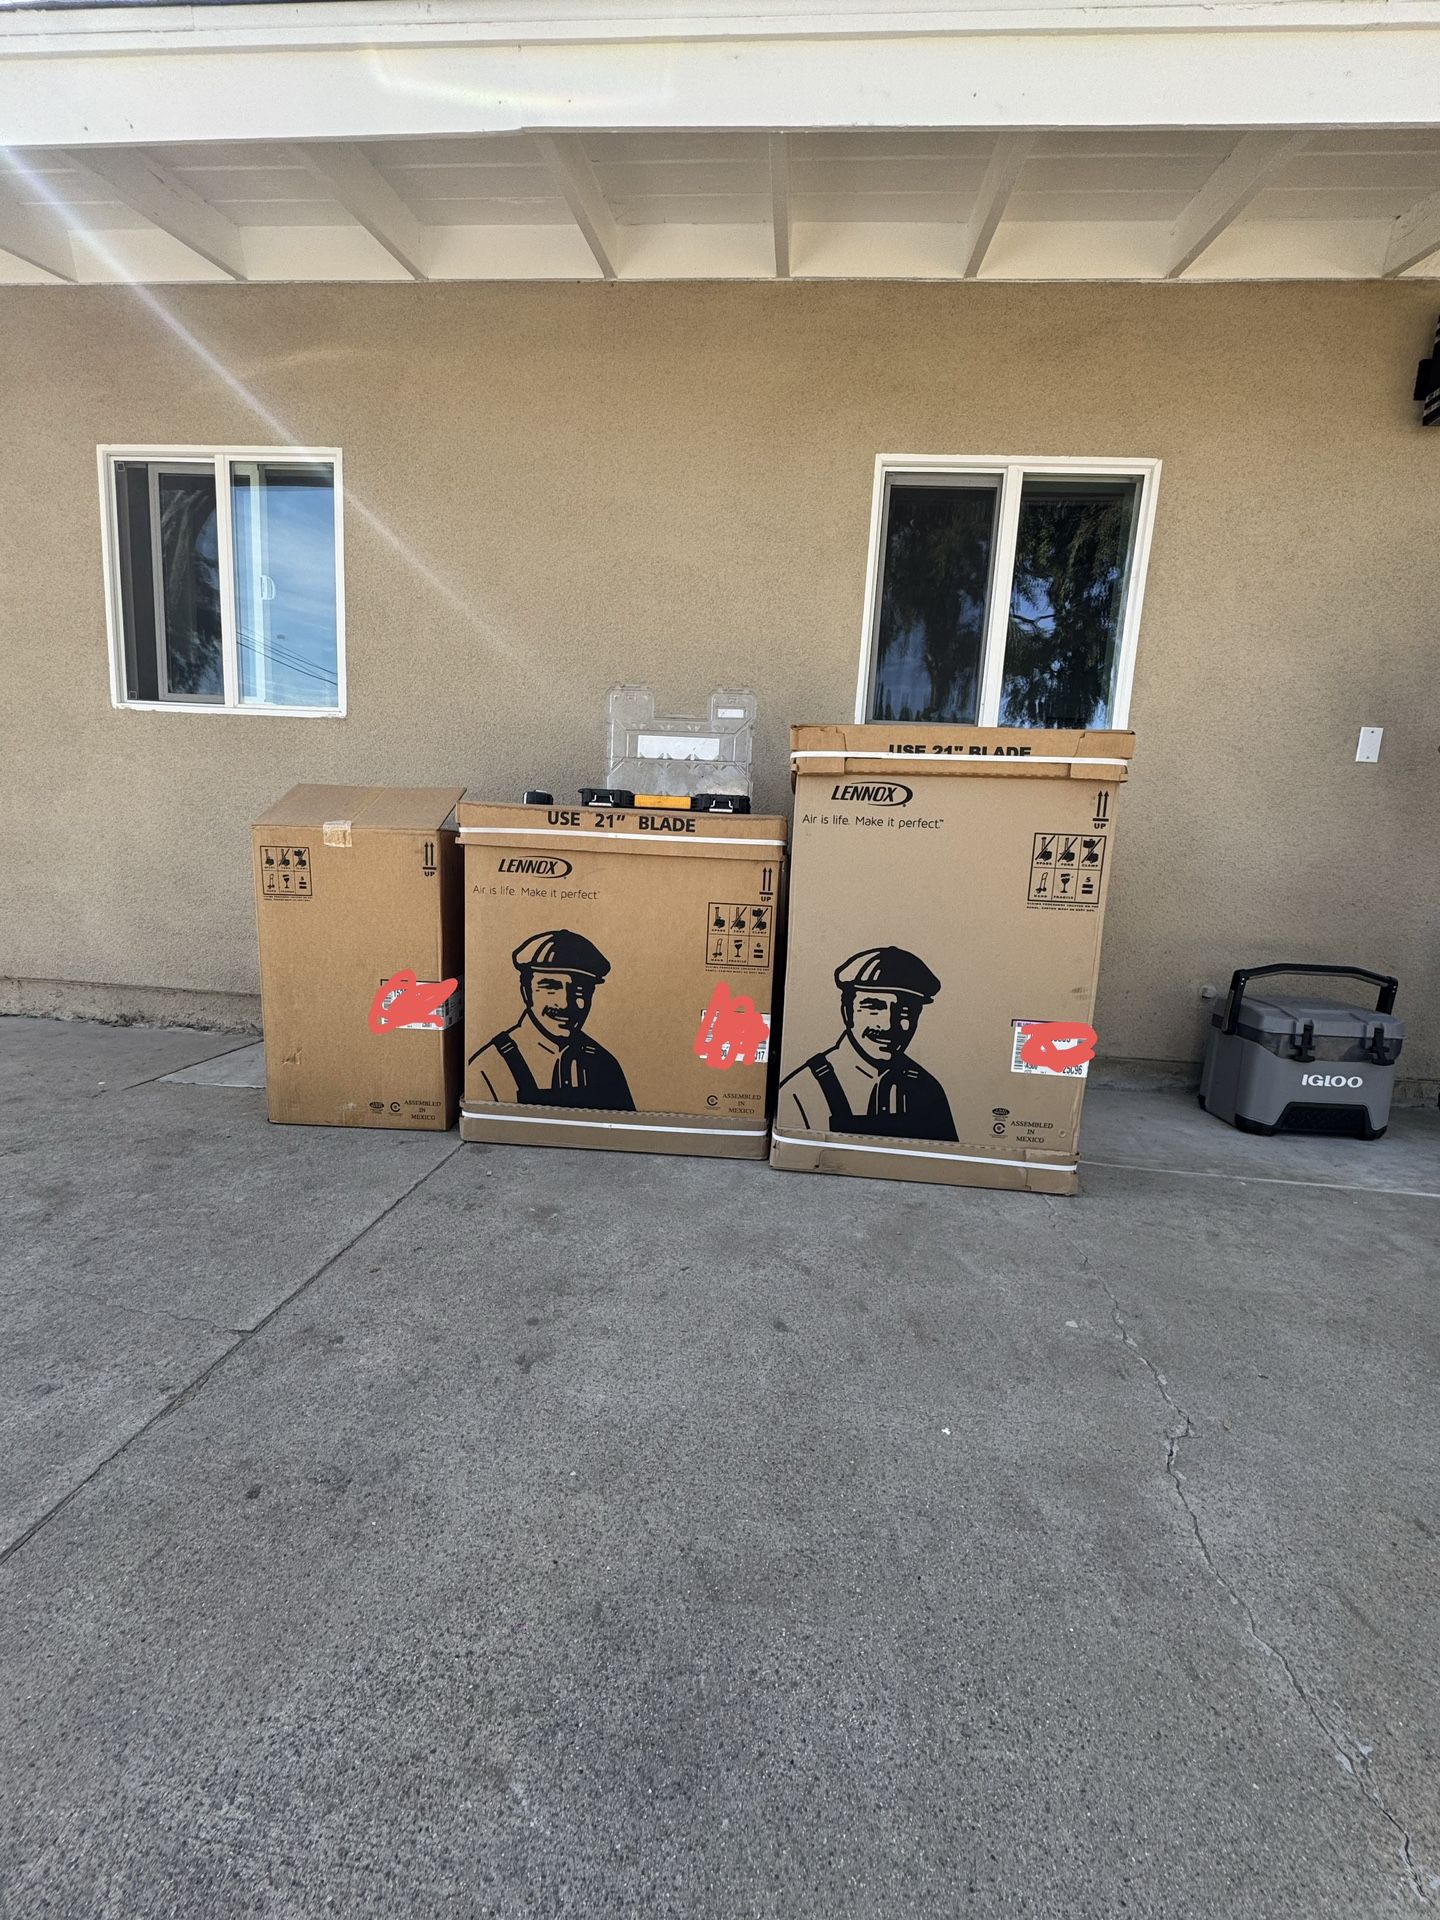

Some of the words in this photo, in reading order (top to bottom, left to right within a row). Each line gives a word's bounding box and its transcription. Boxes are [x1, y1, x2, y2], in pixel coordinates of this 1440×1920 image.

[831, 785, 898, 802] LENNOX
[548, 811, 580, 826] USE
[638, 816, 696, 832] BLADE
[802, 814, 817, 824] Air
[821, 815, 829, 824] is
[855, 816, 884, 827] Make
[887, 817, 895, 827] it
[498, 858, 558, 875] LENNOX
[473, 885, 486, 894] Air
[489, 886, 497, 895] is
[521, 887, 547, 898] Make
[550, 888, 557, 898] it
[1301, 1074, 1363, 1088] IGLOO
[1010, 1120, 1054, 1129] ASSEMBLED
[1016, 1136, 1045, 1144] MEXICO
